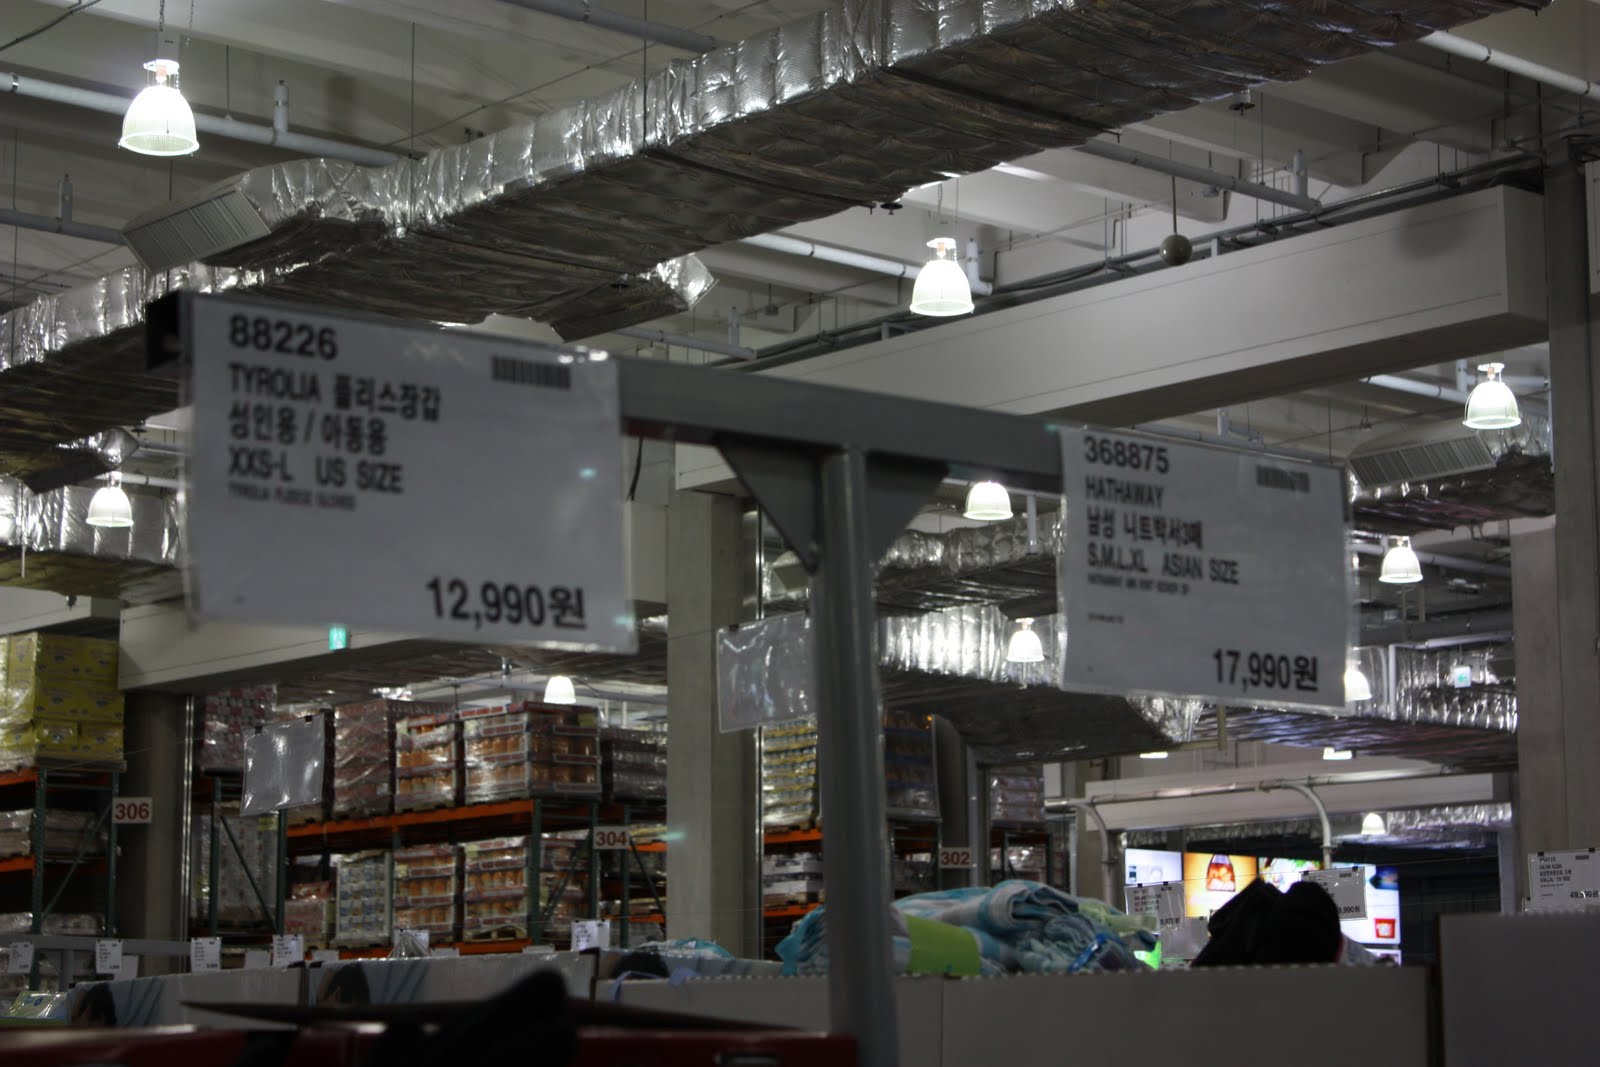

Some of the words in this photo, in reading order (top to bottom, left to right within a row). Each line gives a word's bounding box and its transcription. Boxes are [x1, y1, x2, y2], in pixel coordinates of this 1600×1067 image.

[229, 314, 338, 360] 88226
[228, 362, 321, 403] TYROLIA
[228, 444, 295, 483] XXS-L
[315, 455, 346, 488] US
[356, 460, 404, 494] SIZE
[1084, 436, 1169, 474] 368875
[1086, 475, 1164, 508] HATHAWAY
[1087, 504, 1114, 539] 남성
[1162, 552, 1203, 579] ASIAN
[1209, 557, 1240, 585] SIZE
[426, 576, 587, 630] 12,990원
[1213, 648, 1318, 693] 17,990원
[115, 802, 150, 821] 306
[595, 830, 628, 847] 304
[941, 851, 970, 865] 302
